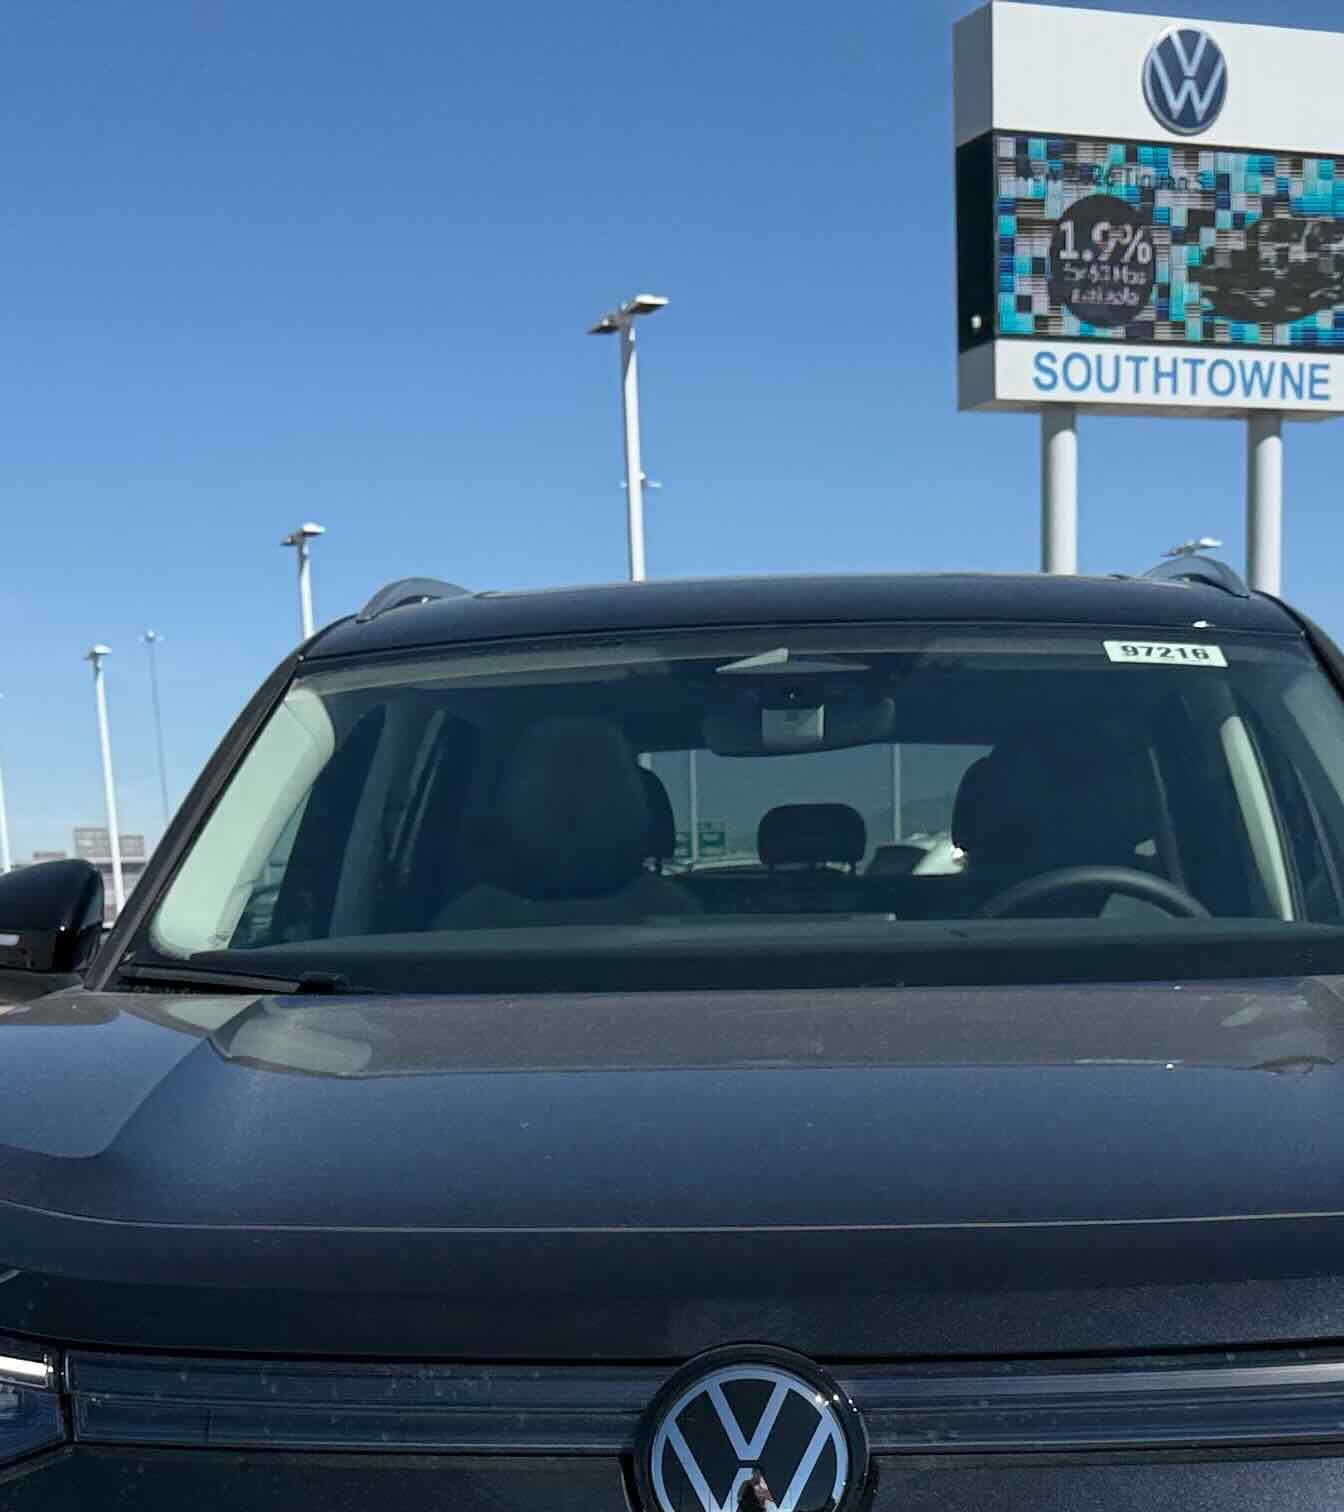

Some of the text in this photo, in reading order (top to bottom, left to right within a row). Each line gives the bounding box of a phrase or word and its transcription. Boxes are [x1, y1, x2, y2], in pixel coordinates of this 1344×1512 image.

[1148, 29, 1227, 124] VW
[1059, 221, 1152, 264] 1.9%
[1032, 352, 1332, 401] SOUTHTOWNE
